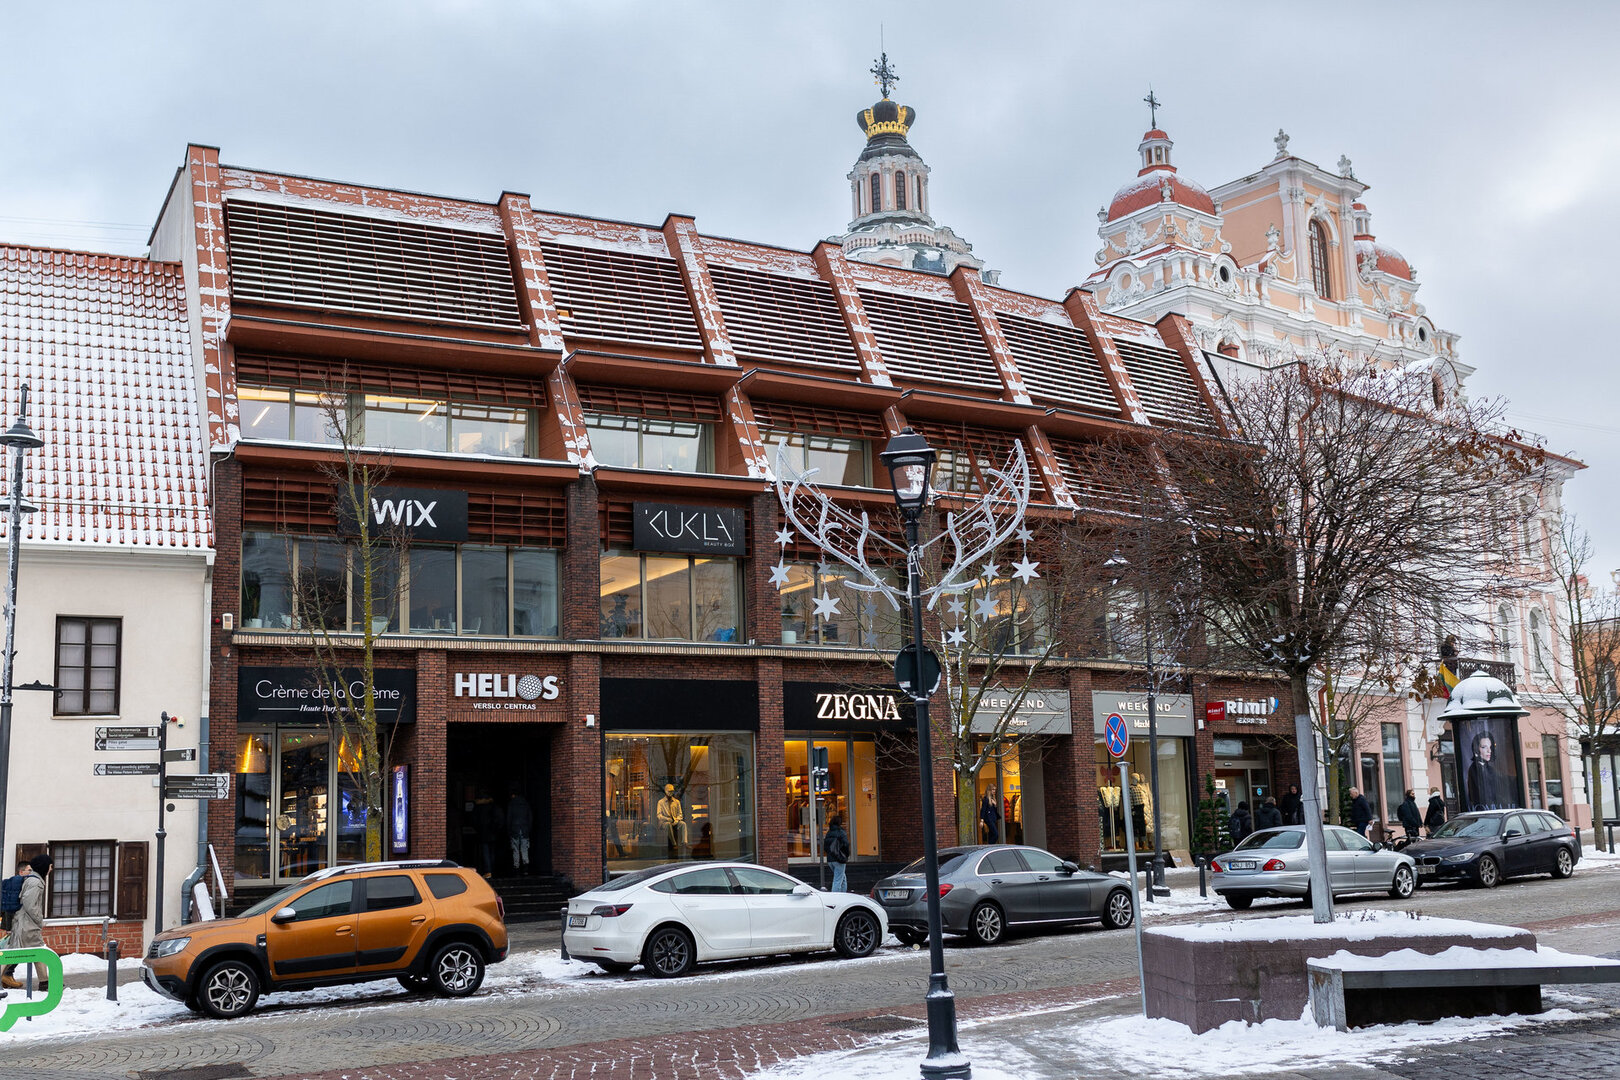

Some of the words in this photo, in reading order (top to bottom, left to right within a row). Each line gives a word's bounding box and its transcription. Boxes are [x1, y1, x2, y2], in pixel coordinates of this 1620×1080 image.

[255, 679, 309, 699] Crème
[312, 684, 330, 699] de
[333, 681, 346, 699] la
[349, 680, 400, 700] Cème
[455, 672, 559, 700] HELIOS
[300, 704, 321, 712] Haute
[473, 702, 502, 710] VERSLO
[504, 703, 537, 711] CENTRAS
[815, 693, 902, 720] ZEGNA
[1117, 701, 1171, 712] WEEKND
